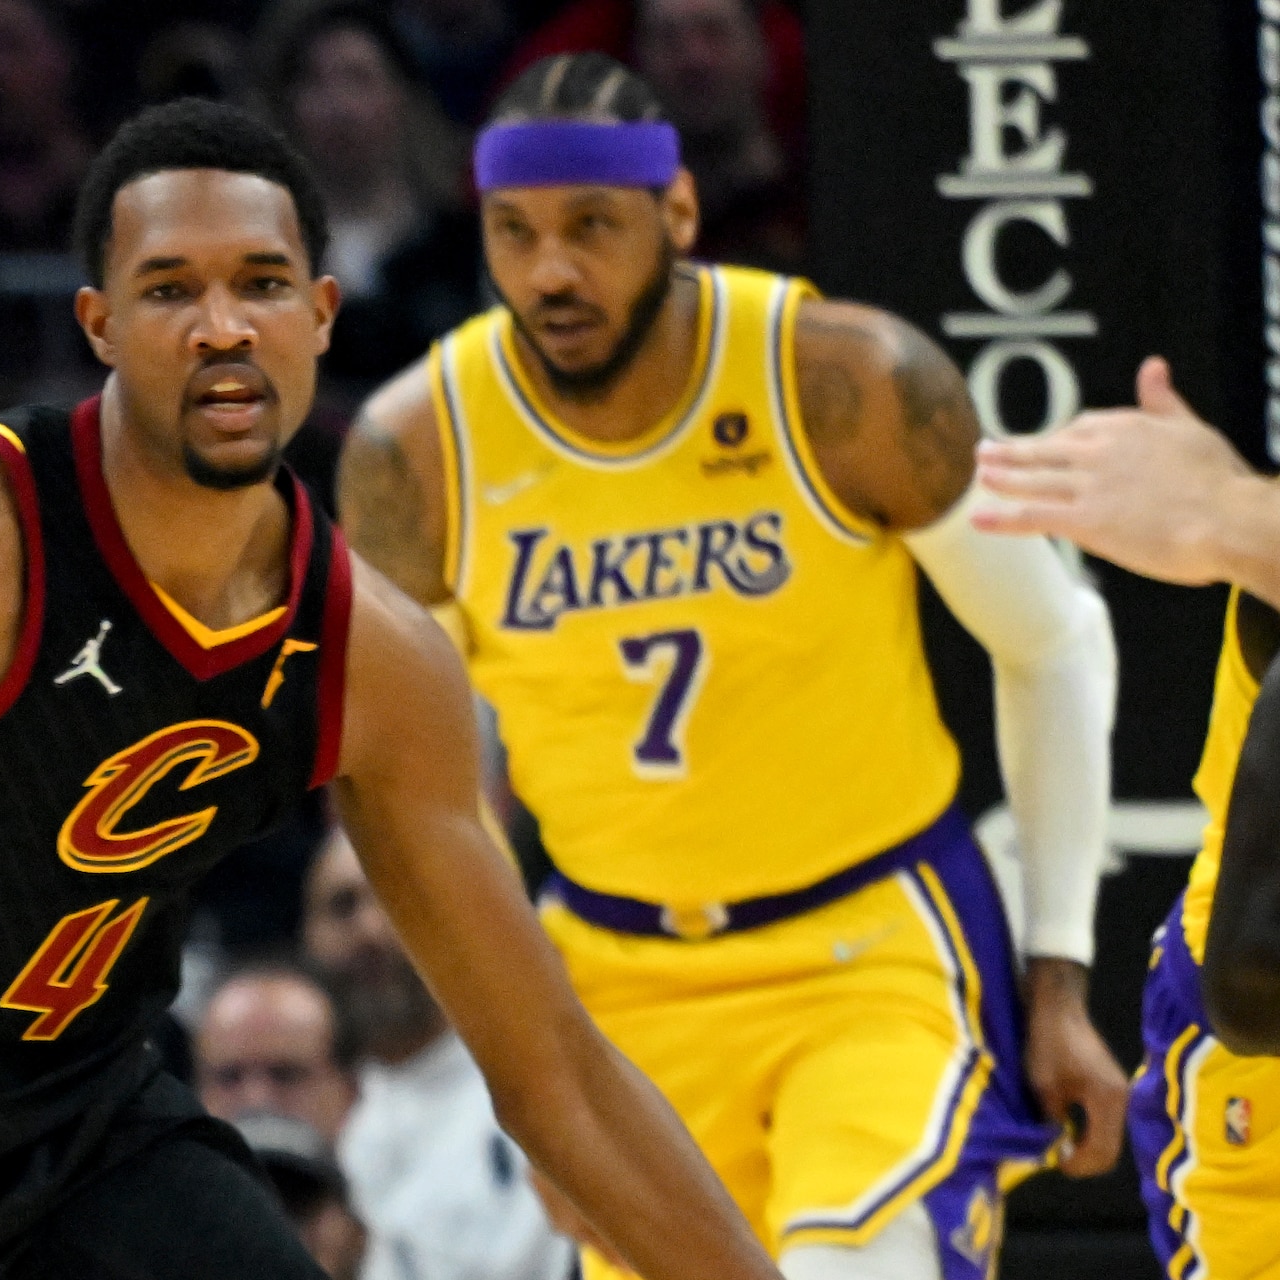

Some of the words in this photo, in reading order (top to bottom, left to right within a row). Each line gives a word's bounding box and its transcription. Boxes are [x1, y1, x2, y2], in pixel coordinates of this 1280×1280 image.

[498, 510, 794, 633] LAKERS
[616, 625, 710, 780] 7
[56, 717, 261, 874] C
